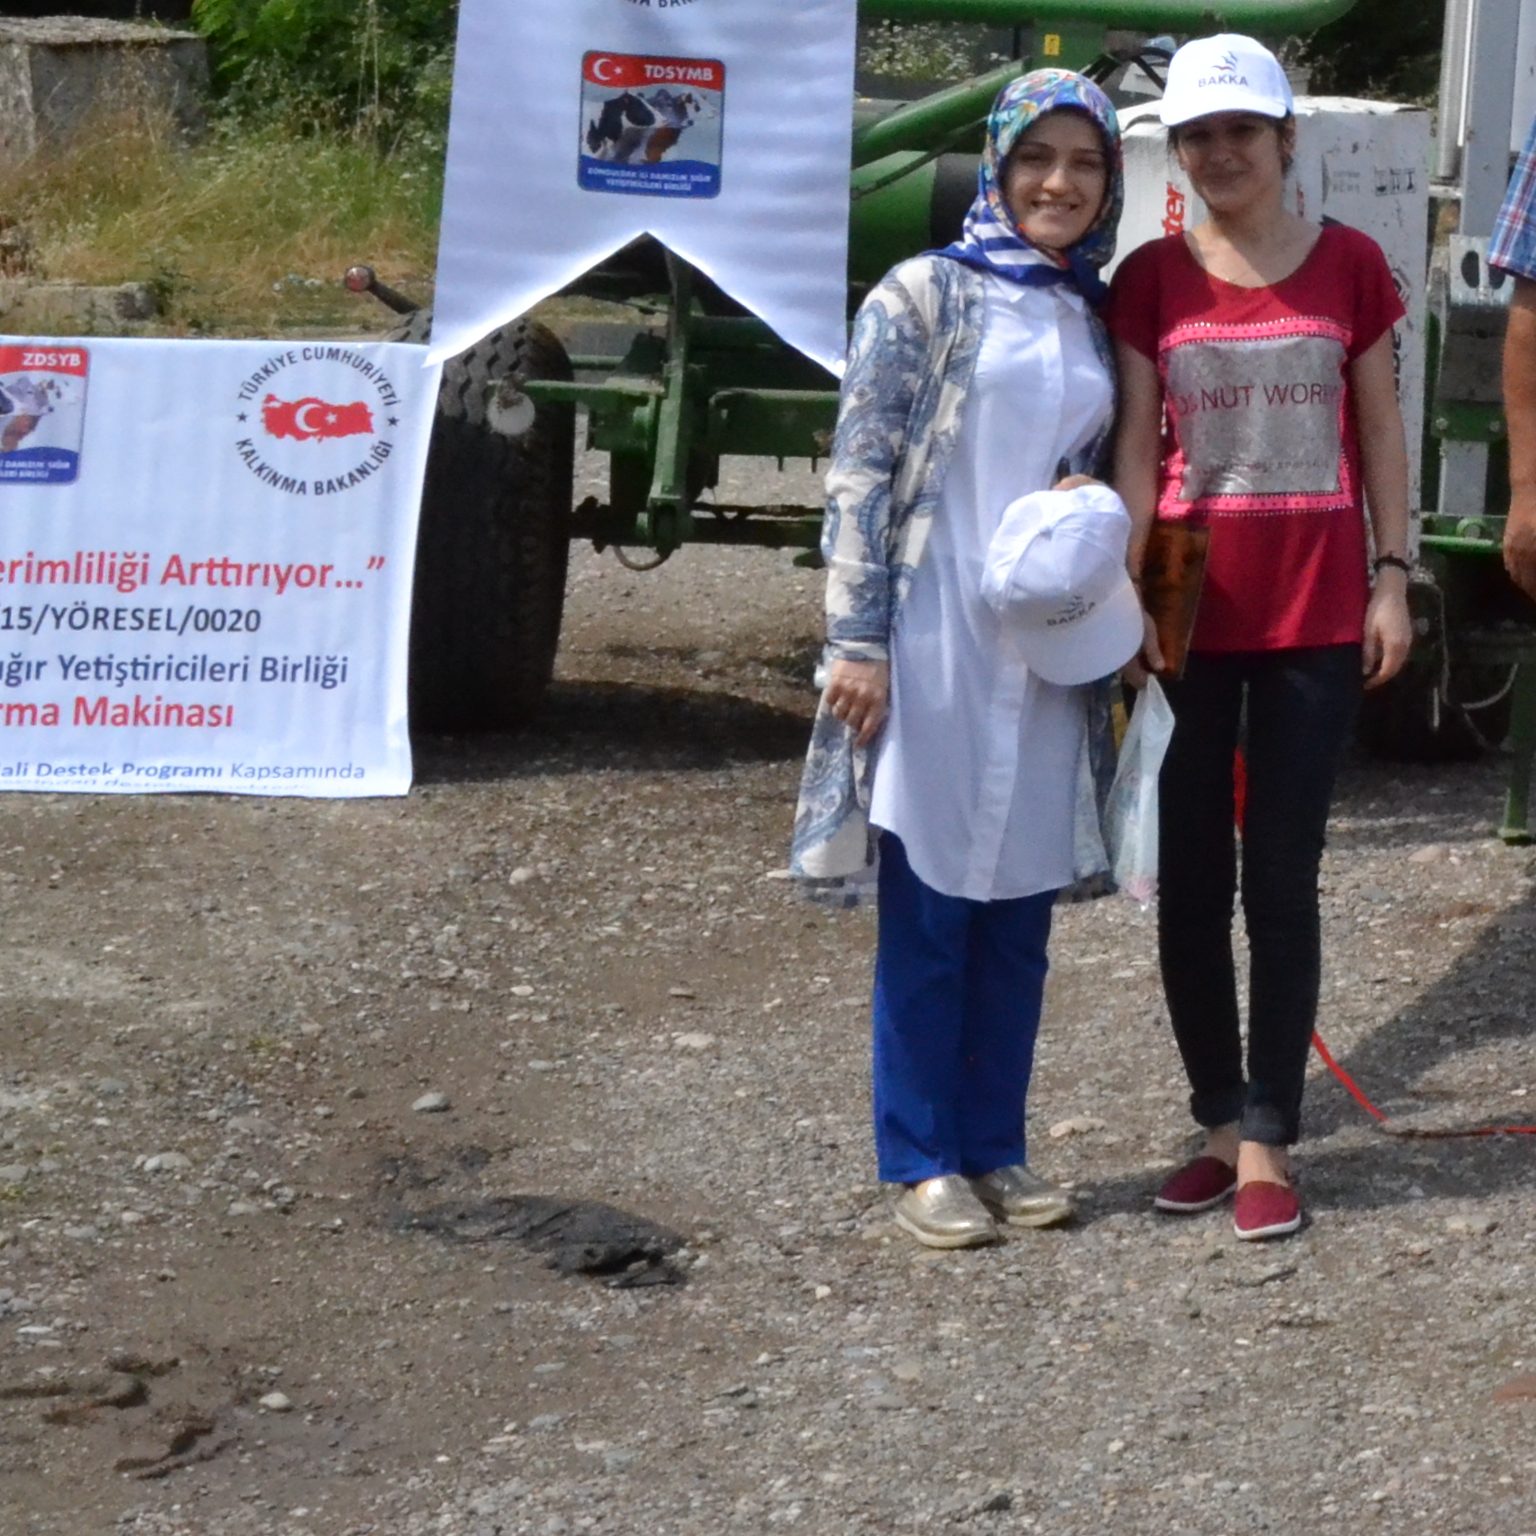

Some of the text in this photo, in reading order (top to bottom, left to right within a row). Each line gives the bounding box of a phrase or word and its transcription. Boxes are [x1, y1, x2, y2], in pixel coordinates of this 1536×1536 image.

[644, 64, 714, 81] TDSYMB
[1198, 74, 1249, 88] BAKKA
[22, 352, 81, 366] ZDSYB
[238, 346, 401, 406] TÜRKİYE CUMHURİYETİ
[236, 438, 393, 496] KALKINMA BAKANLIĞI
[0, 602, 261, 635] 15/YÖRESEL/0020
[58, 654, 249, 688] Yetiştiricileri
[260, 655, 348, 689] Birliği
[73, 695, 234, 727] Makinası
[36, 762, 113, 778] Destek
[121, 762, 222, 781] Programı
[230, 762, 366, 781] Kapsamında
